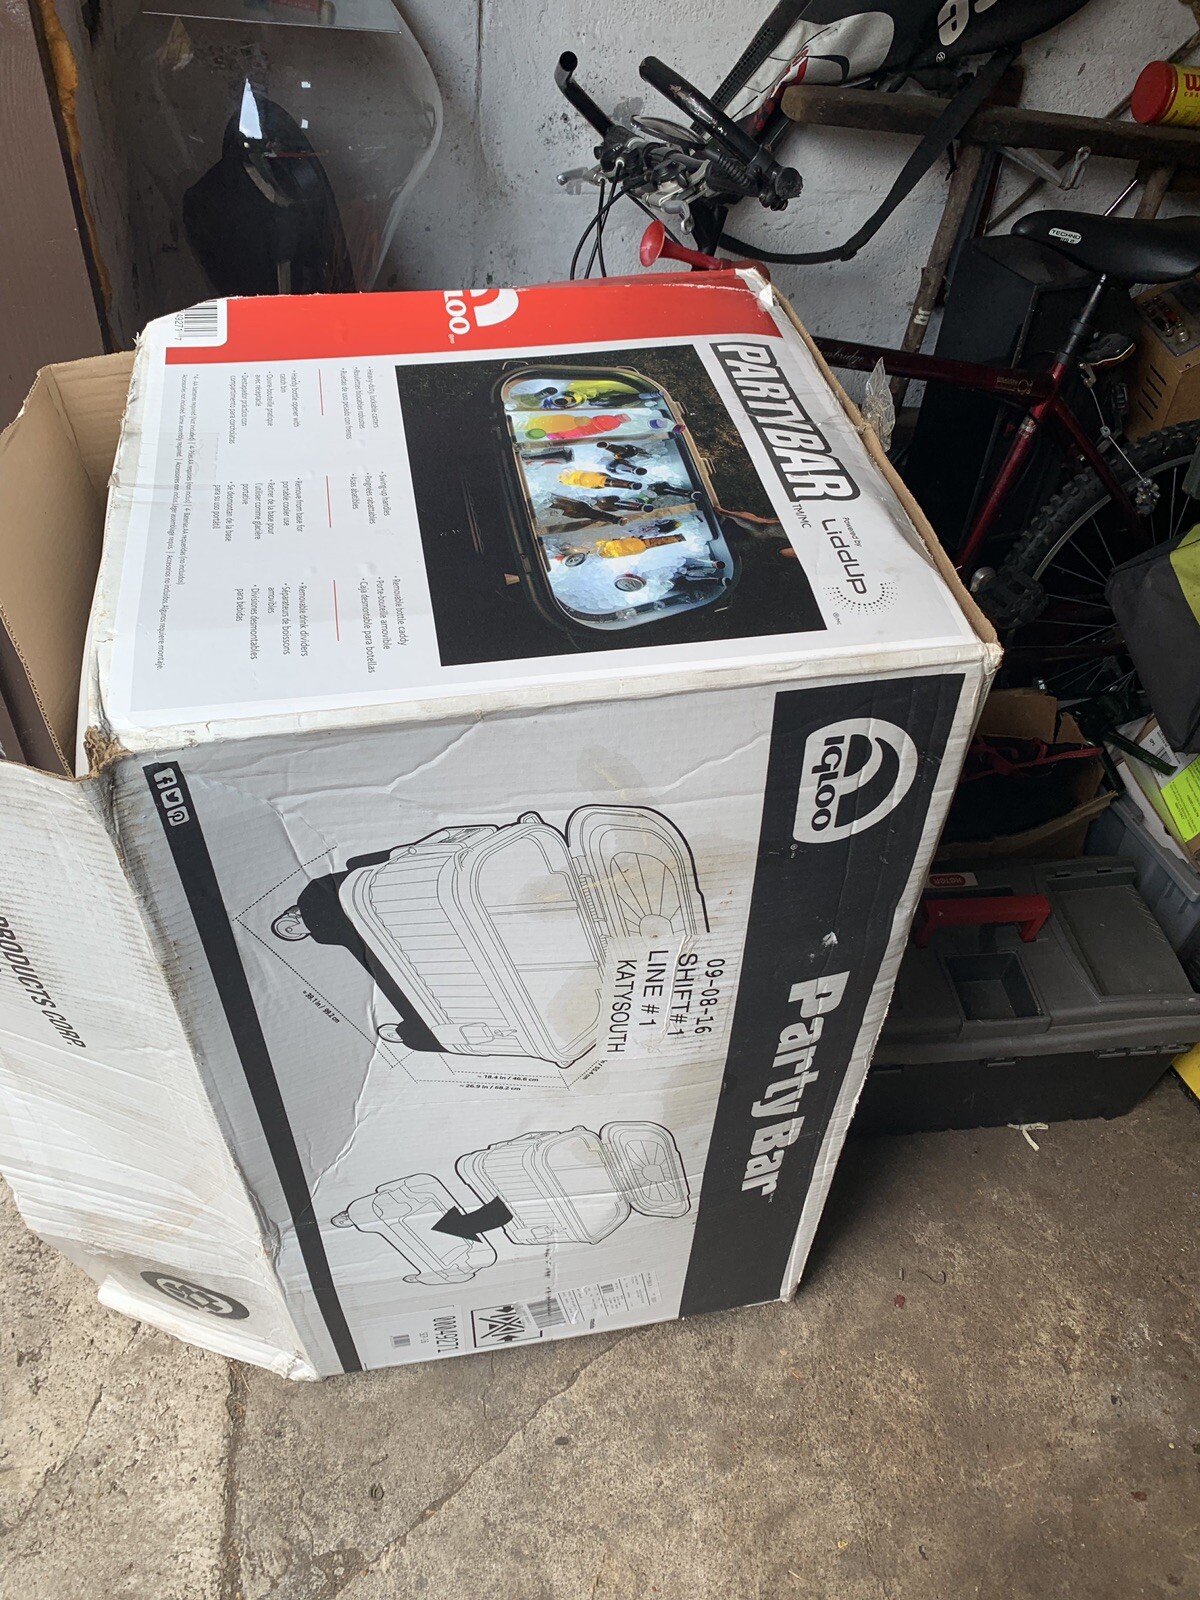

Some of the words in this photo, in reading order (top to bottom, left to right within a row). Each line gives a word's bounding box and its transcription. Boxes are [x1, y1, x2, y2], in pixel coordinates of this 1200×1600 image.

[712, 343, 859, 501] PARTYBAR
[212, 485, 221, 495] para
[240, 484, 250, 504] portative
[280, 481, 291, 500] portable
[295, 481, 303, 499] Remove
[363, 476, 374, 496] Poignées
[377, 475, 389, 496] Swing-up
[226, 491, 235, 517] desmontan
[283, 502, 291, 516] cooler
[296, 500, 304, 511] from
[351, 488, 360, 509] abatibles
[367, 497, 377, 524] rabattables
[382, 497, 391, 516] handles
[268, 511, 276, 522] base
[296, 513, 304, 524] base
[792, 504, 812, 528] TM/MC
[225, 530, 233, 541] base
[252, 521, 263, 539] glacière
[266, 523, 274, 534] pour
[842, 516, 858, 539] Powered
[854, 538, 862, 547] by
[822, 518, 866, 594] LiddUp
[235, 589, 244, 600] para
[358, 582, 369, 593] Caja
[376, 580, 389, 618] Porte-bouteille
[392, 579, 404, 607] Removable
[236, 601, 245, 621] bebidas
[250, 588, 260, 615] Divisiones
[268, 587, 277, 613] amovibles
[279, 586, 291, 617] Séparateurs
[299, 586, 308, 614] Removable
[361, 594, 372, 629] desmontable
[299, 615, 309, 629] drink
[396, 608, 406, 625] bottle
[250, 616, 260, 660] desmontables
[282, 626, 292, 655] boissons
[300, 630, 310, 656] dividers
[362, 631, 372, 645] para
[380, 620, 392, 649] amovible
[397, 626, 409, 646] caddy
[155, 645, 165, 670] montaje.
[366, 646, 377, 673] botellas
[643, 950, 668, 997] LINE
[607, 960, 637, 1052] KATYSOUTH
[694, 958, 726, 1034] 09-08-16
[42, 1010, 86, 1048] CORP.
[433, 1316, 458, 1352] 00049271
